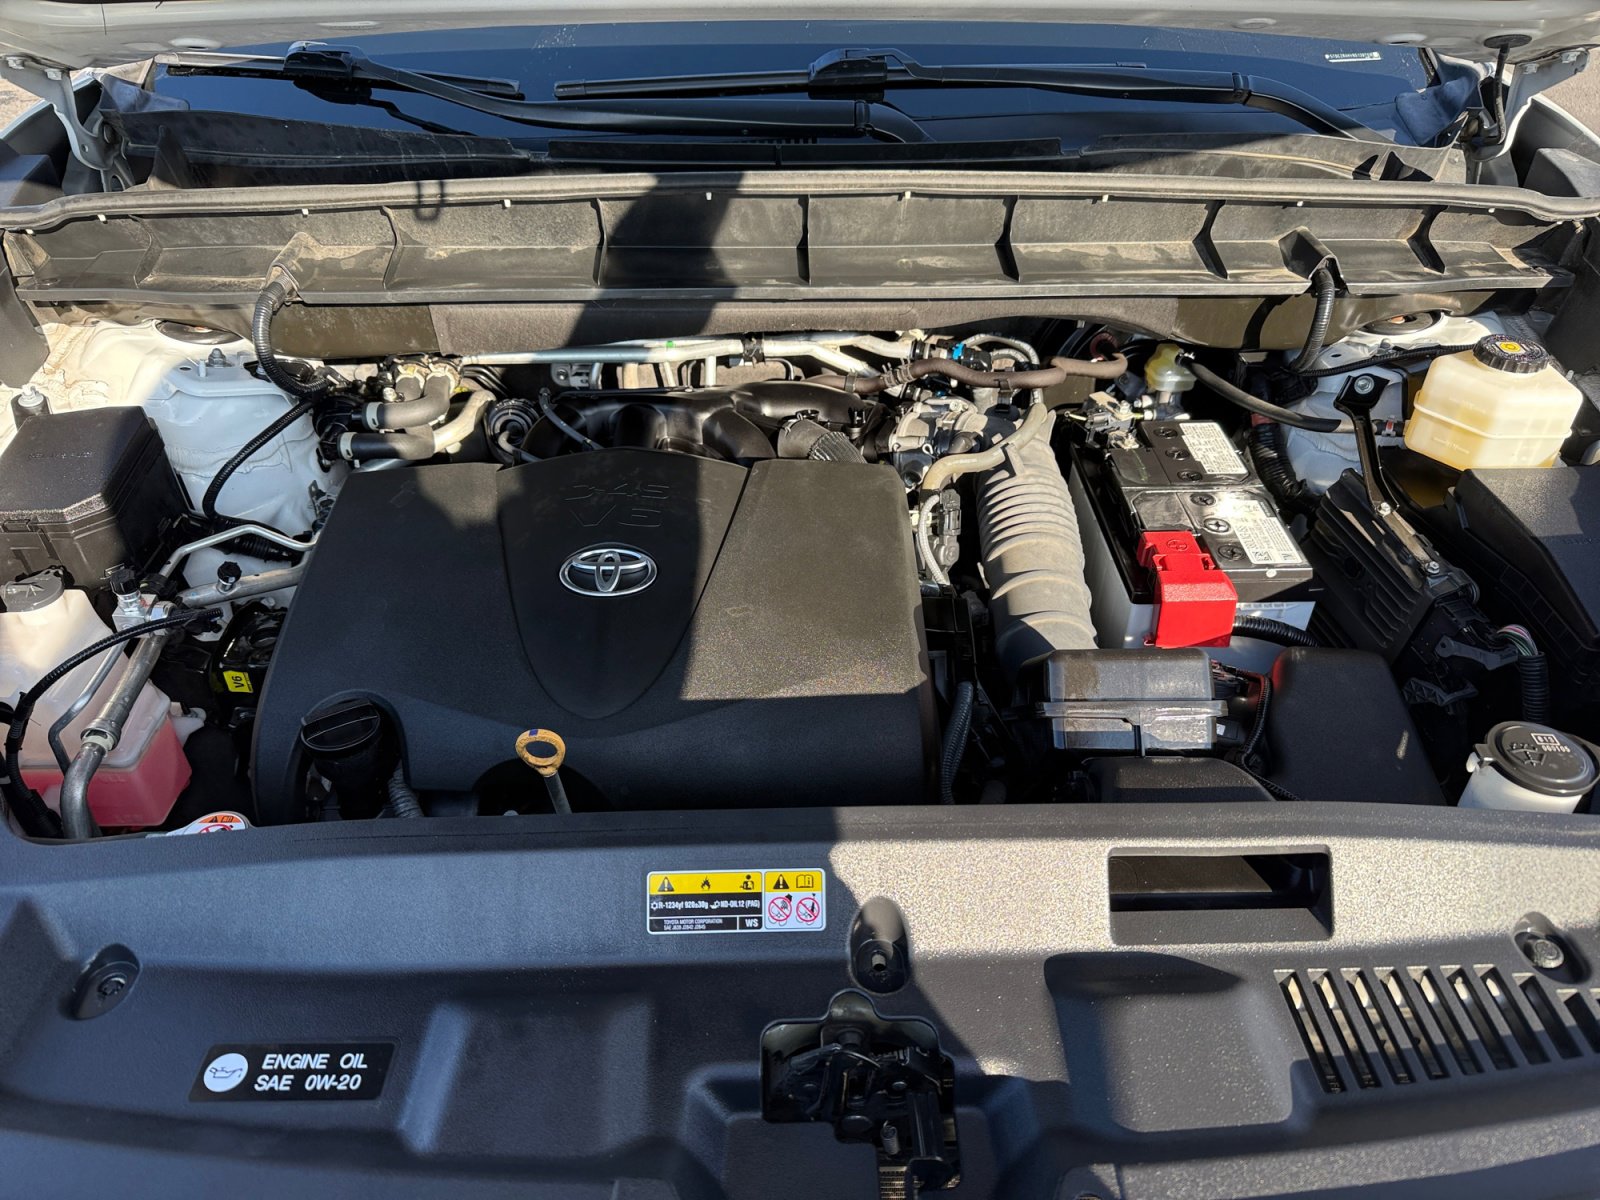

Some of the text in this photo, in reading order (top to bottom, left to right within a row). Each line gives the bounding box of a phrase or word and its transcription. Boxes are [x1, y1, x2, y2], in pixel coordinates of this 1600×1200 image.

[745, 918, 759, 928] WS
[261, 1053, 368, 1070] ENGINE OIL
[253, 1073, 362, 1092] SAE 0W-20
